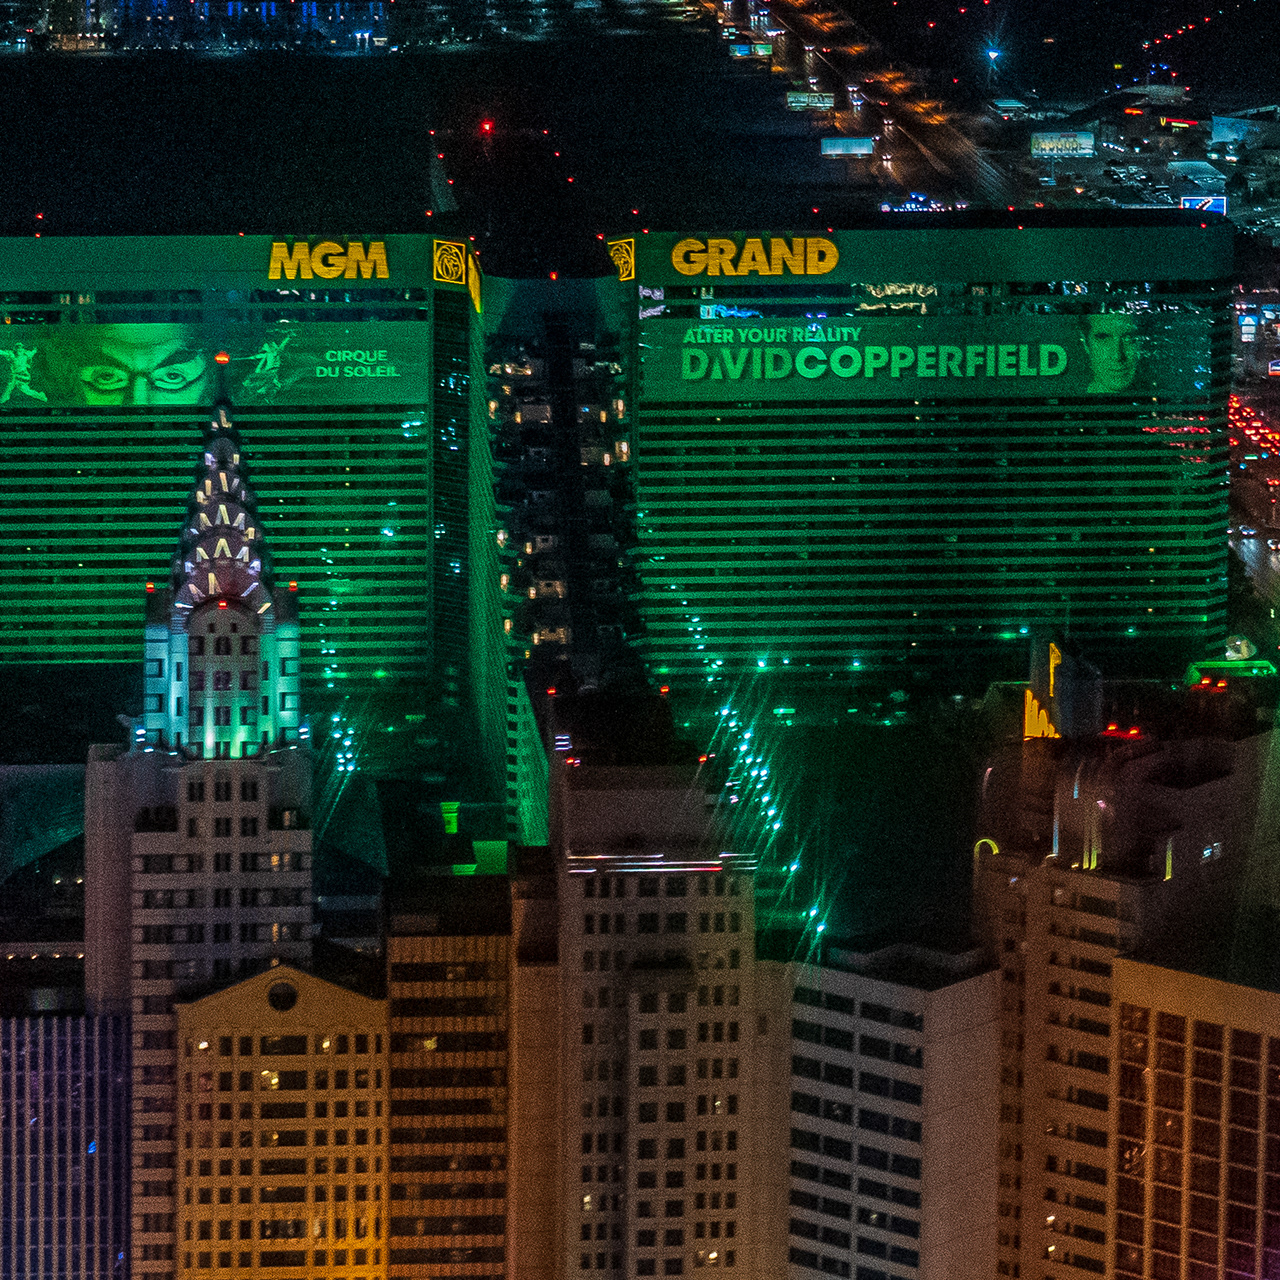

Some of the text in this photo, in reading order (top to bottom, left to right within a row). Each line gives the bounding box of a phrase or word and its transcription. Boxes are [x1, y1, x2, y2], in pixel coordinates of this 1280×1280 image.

[268, 241, 390, 280] MGM
[670, 237, 840, 276] GRAND
[683, 326, 862, 344] ALTER YOUR REALITY
[325, 349, 388, 366] CIRQUE
[315, 365, 401, 378] DU SOLEIL
